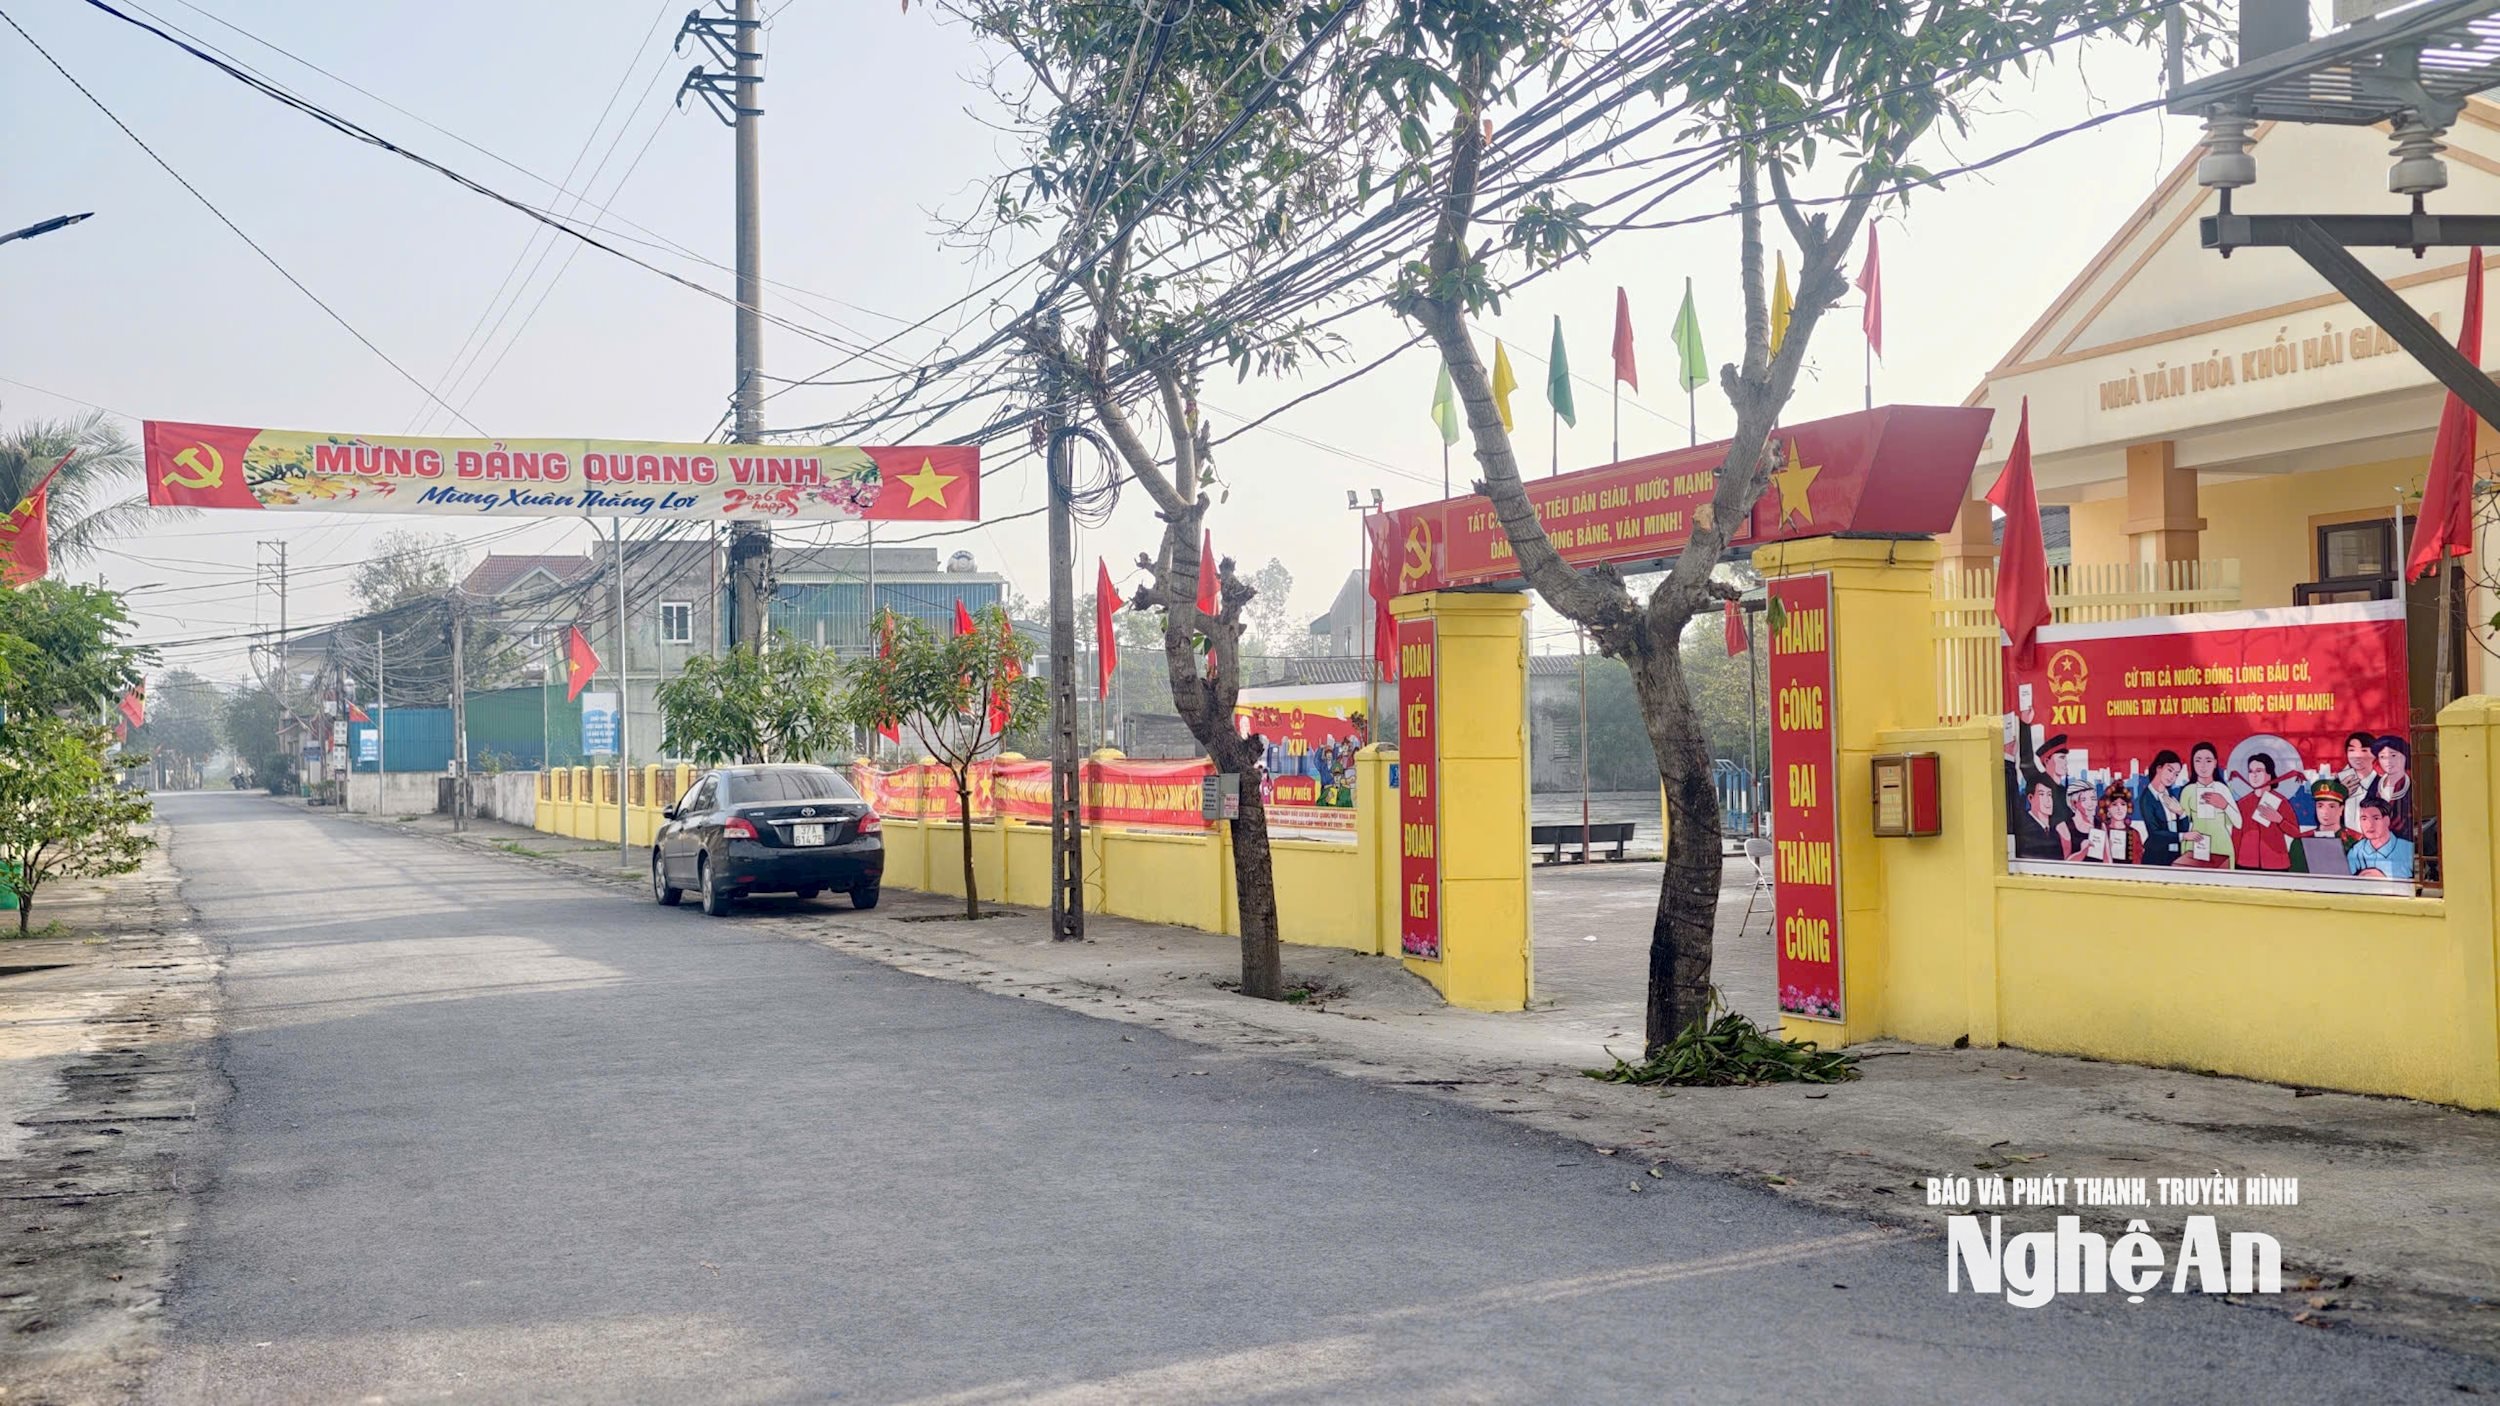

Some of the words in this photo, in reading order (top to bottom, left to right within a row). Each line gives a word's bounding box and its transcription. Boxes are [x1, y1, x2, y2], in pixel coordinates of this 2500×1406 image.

[2099, 367, 2140, 411] NHÀ
[2143, 360, 2186, 402] VĂN
[2191, 348, 2236, 393] HÓA
[2241, 325, 2298, 383] KHỐI
[2303, 321, 2344, 371] HẢI
[2350, 325, 2400, 361] GIA
[314, 438, 445, 478] MỪNG
[454, 441, 571, 482] ĐẢNG
[582, 453, 718, 486] QUANG
[728, 456, 822, 486] VINH
[498, 488, 575, 508] Xuân
[577, 489, 656, 517] Thắng
[659, 491, 700, 512] Lợi
[1467, 508, 1486, 533] TẤT
[1544, 496, 1569, 520] TIÊU
[1572, 490, 1597, 516] DÂN
[1599, 484, 1632, 509] GIÀU,
[1635, 478, 1670, 503] NƯỚC
[1673, 469, 1714, 500] MẠNH
[1490, 537, 1513, 560] DÂN
[1576, 519, 1613, 548] BẰNG,
[1615, 514, 1641, 541] VĂN
[1643, 510, 1683, 536] MINH!
[1402, 637, 1432, 679] ĐOÀN
[2124, 664, 2140, 688] CỬ
[2140, 671, 2156, 688] TRI
[2157, 664, 2172, 687] CẢ
[2173, 662, 2202, 686] NƯỚC
[2235, 662, 2265, 684] LÒNG
[2292, 657, 2311, 683] CỬ,
[1407, 692, 1428, 738] KẾT
[1778, 678, 1823, 732] CÔNG
[2050, 704, 2087, 725] XVI
[2106, 699, 2140, 717] CHUNG
[2141, 699, 2158, 716] TAY
[2159, 694, 2179, 715] XÂY
[2181, 696, 2210, 718] DỰNG
[2211, 690, 2232, 714] ĐẤT
[2234, 692, 2264, 714] NƯỚC
[2266, 690, 2293, 713] GIÀU
[2295, 692, 2335, 716] MẠNH!
[1287, 738, 1308, 757] XVI
[1408, 763, 1428, 805] ĐẠI
[1788, 764, 1817, 817] ĐẠI
[1404, 816, 1434, 859] ĐOÀN
[1778, 832, 1832, 886] THÀNH
[1410, 872, 1430, 920] KẾT
[1785, 909, 1831, 963] CÔNG
